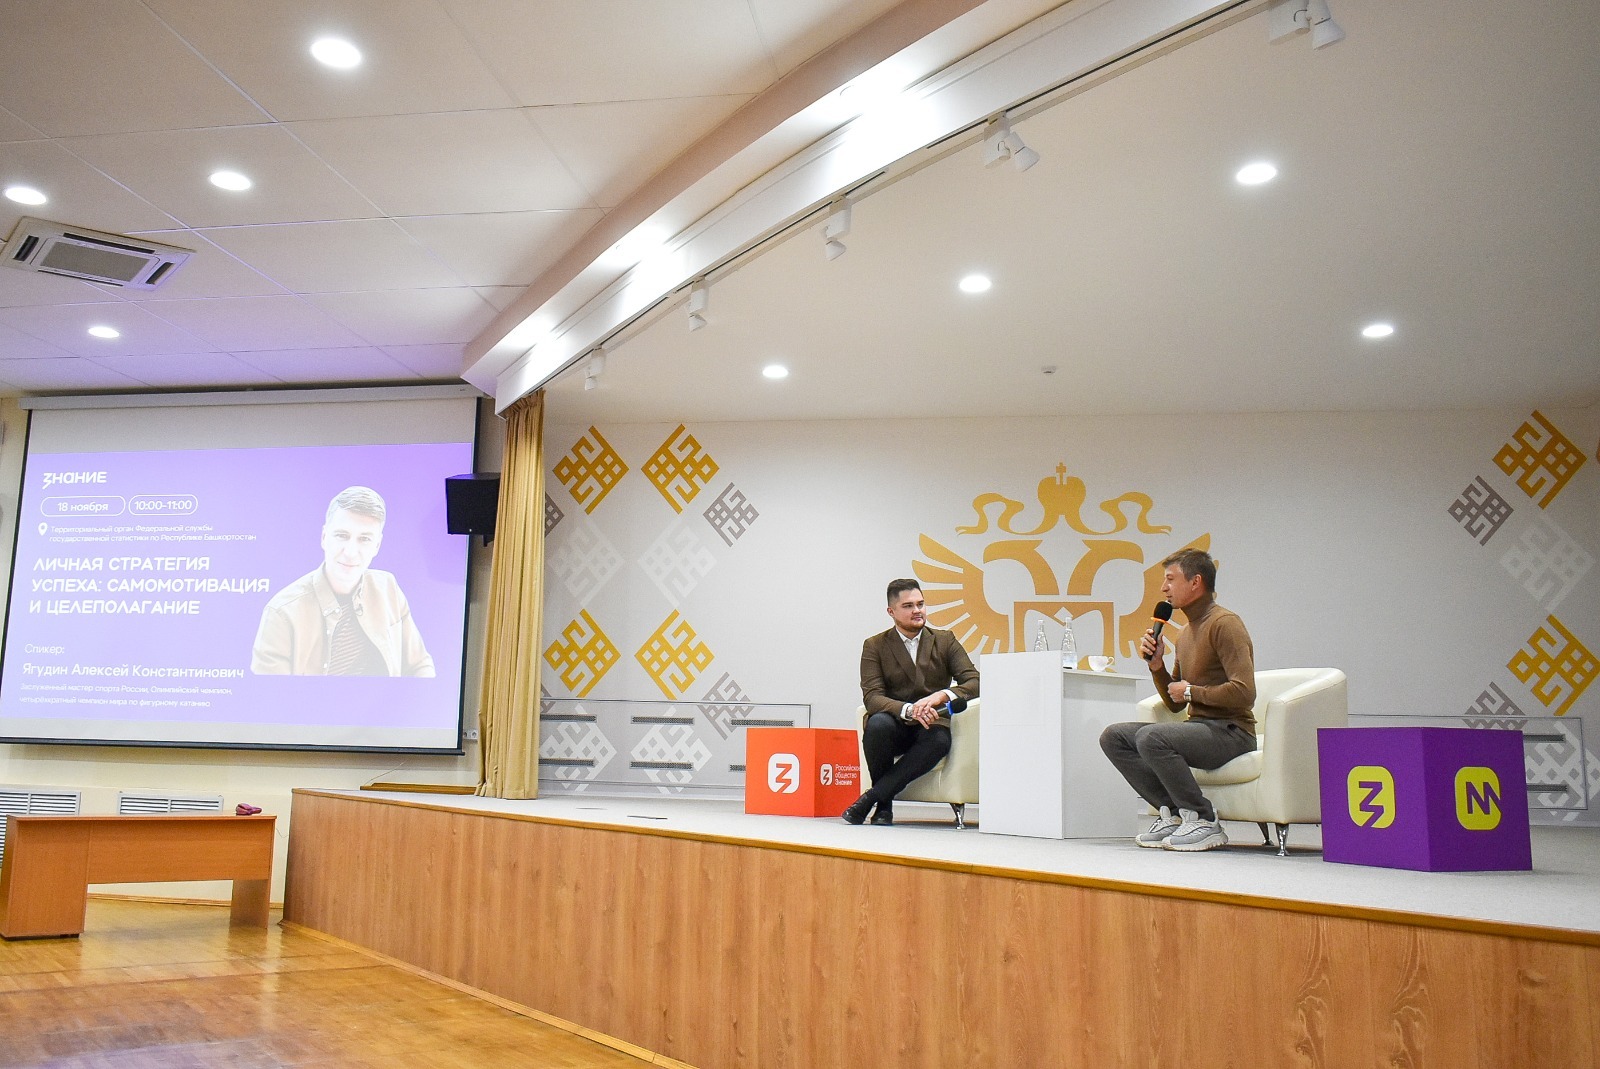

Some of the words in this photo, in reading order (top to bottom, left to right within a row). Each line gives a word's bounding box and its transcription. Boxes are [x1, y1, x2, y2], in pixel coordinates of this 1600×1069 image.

[57, 501, 68, 512] 18
[70, 501, 109, 513] ноября
[134, 499, 193, 511] 10:00-11:00
[51, 525, 112, 534] Территориальный
[114, 526, 134, 534] орган
[135, 524, 184, 533] Федеральной
[185, 524, 213, 533] службы
[49, 534, 109, 543] государственной
[111, 534, 149, 542] статистики
[160, 534, 202, 543] Республике
[204, 533, 257, 542] Башкортостан
[33, 557, 103, 571] ЛИЧНАЯ
[108, 556, 210, 571] СТРАТЕГИЯ
[31, 578, 102, 592] УСПЕХА:
[107, 578, 270, 595] САМОМОТИВАЦИЯ
[29, 600, 41, 613] И
[47, 600, 200, 615] ЦЕЛЕПОЛАГАНИЕ
[24, 643, 65, 656] Спикер:
[23, 663, 68, 677] Ягудин
[71, 663, 129, 677] Алексей
[132, 665, 244, 678] Константинович
[834, 771, 858, 780] общество
